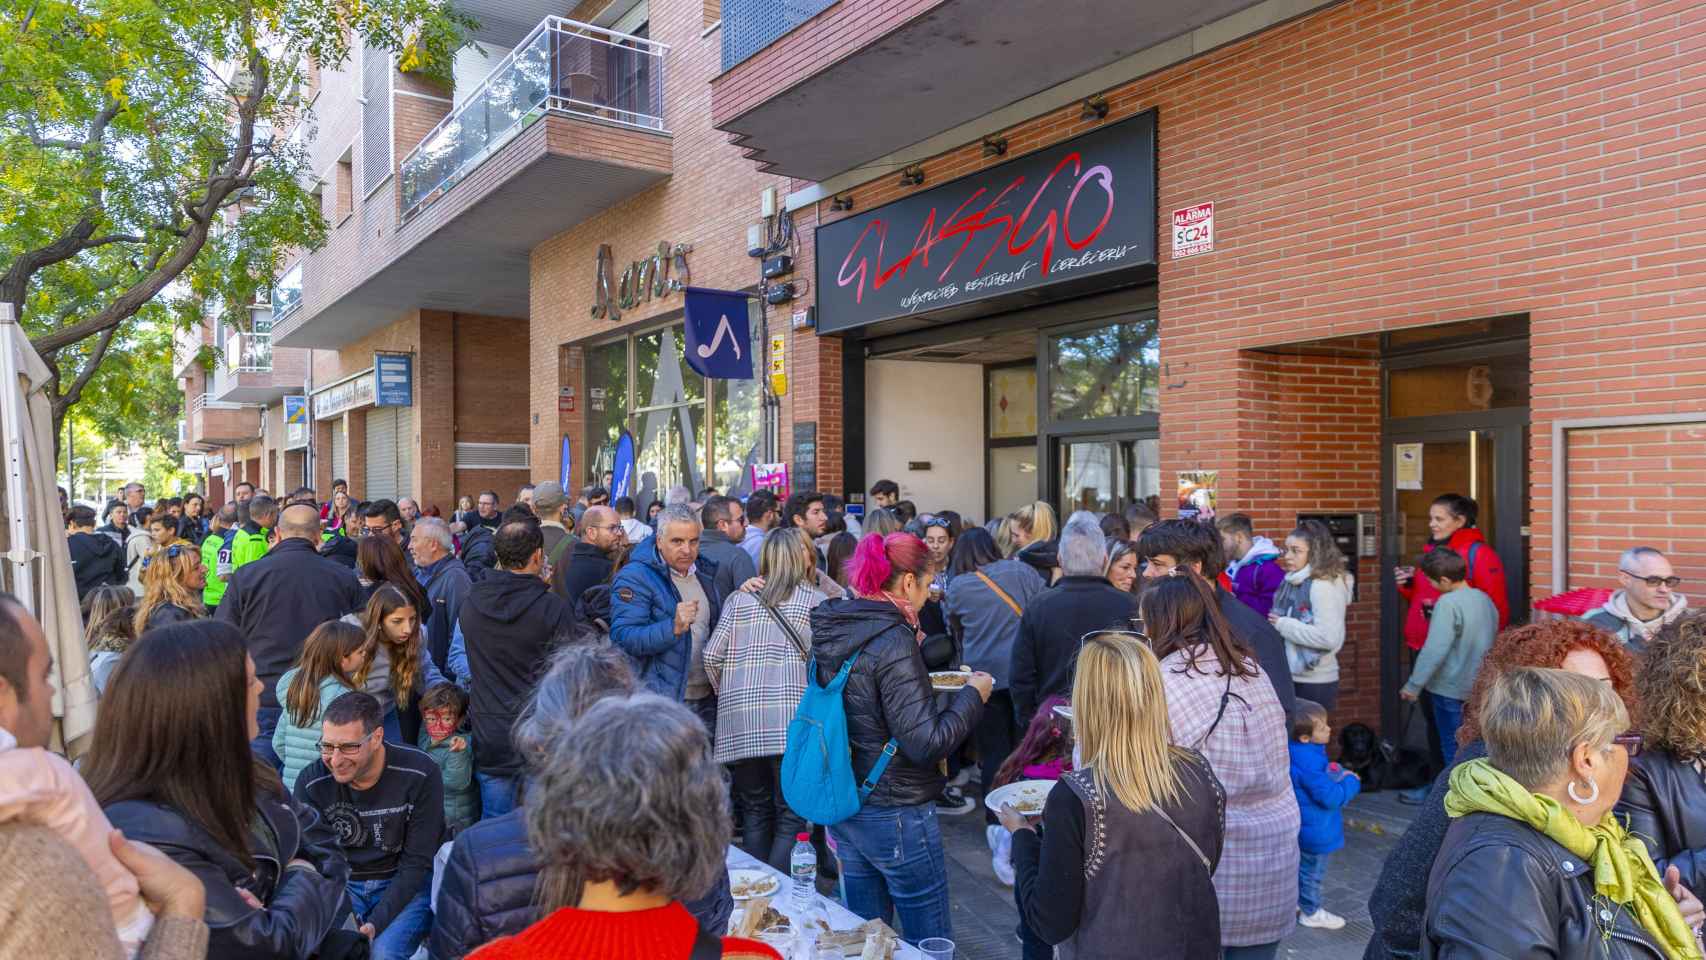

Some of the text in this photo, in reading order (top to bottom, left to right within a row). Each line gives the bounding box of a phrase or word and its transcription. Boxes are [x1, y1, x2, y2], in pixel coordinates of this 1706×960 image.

[838, 152, 1114, 304] GLASSGO
[1174, 207, 1212, 225] ALARMA
[1177, 225, 1209, 244] SC24
[900, 283, 959, 312] UNEXPECTED
